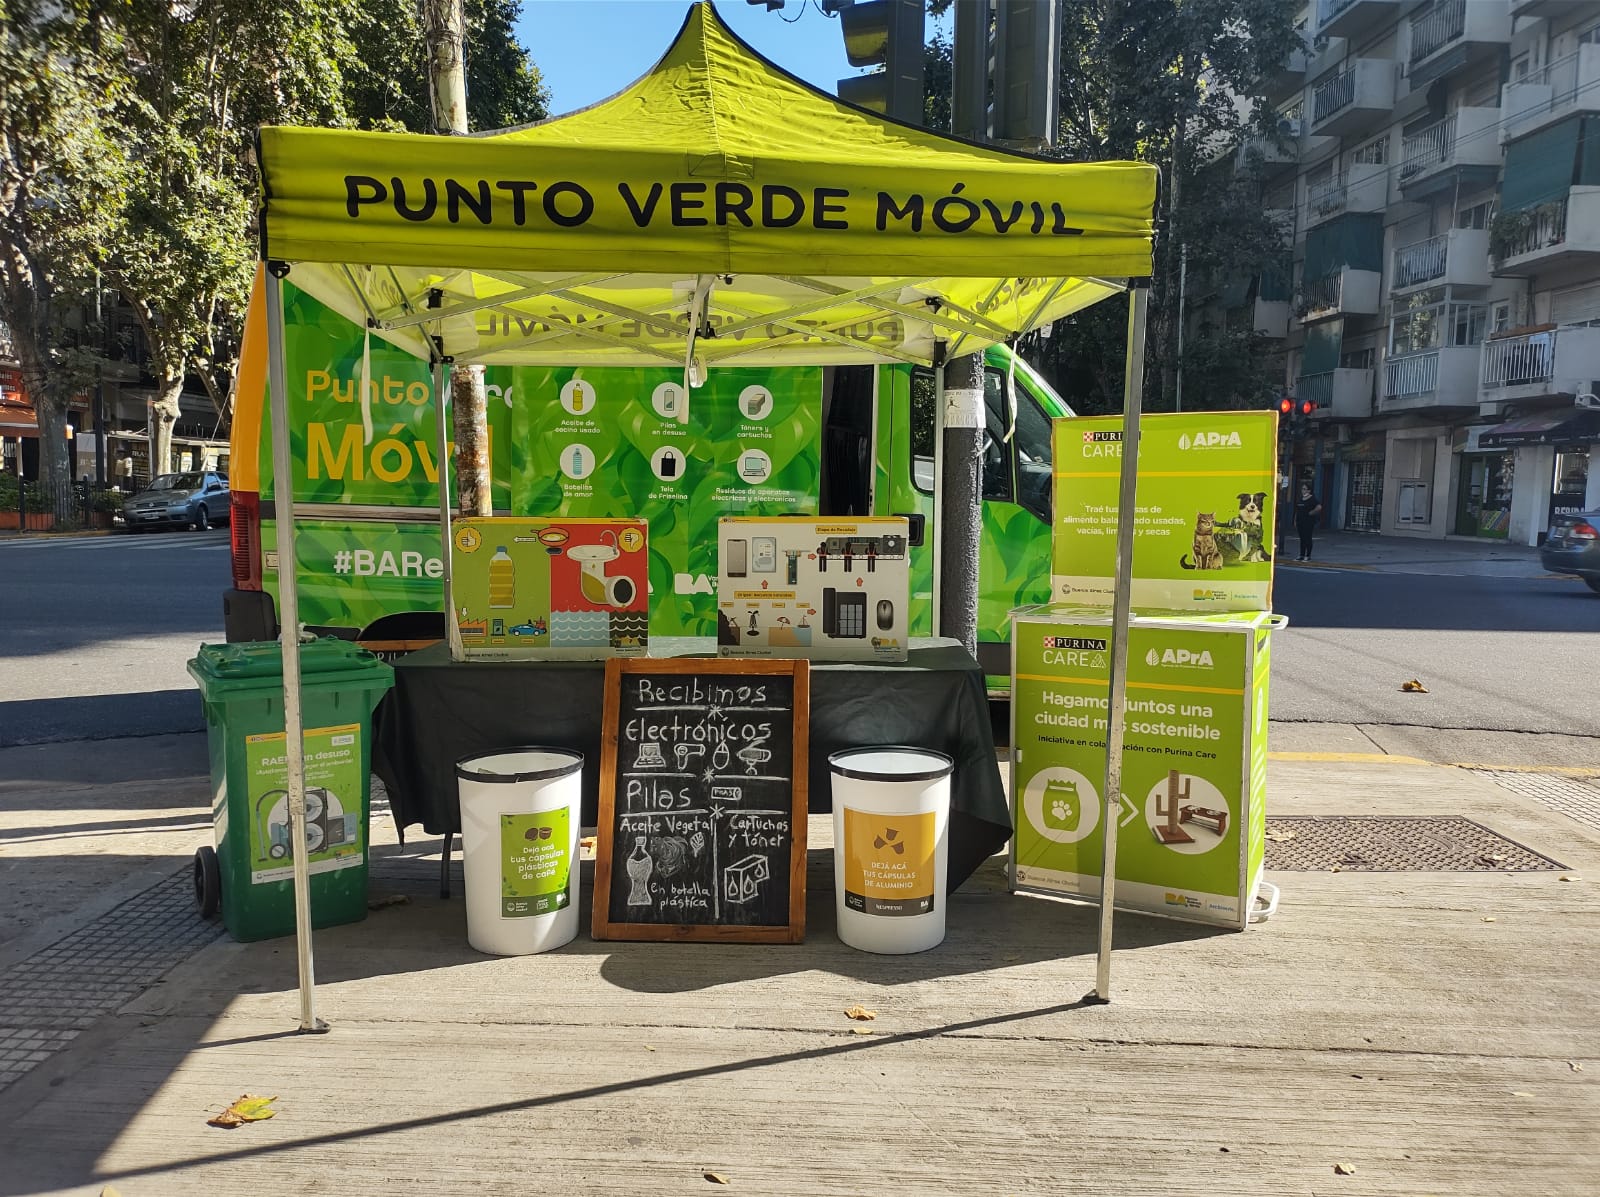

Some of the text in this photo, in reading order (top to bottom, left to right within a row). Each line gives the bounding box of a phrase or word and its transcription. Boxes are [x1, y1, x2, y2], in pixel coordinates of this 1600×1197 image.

[344, 175, 1084, 235] PUNTO VERDE MÓVIL
[1095, 432, 1122, 441] PURI
[1192, 431, 1242, 447] APrA
[307, 423, 493, 483] Móv
[1085, 505, 1104, 513] Traé
[1063, 516, 1099, 524] alimento
[1152, 517, 1186, 526] usadas,
[1077, 526, 1105, 535] vacías,
[1145, 528, 1171, 536] secas
[1056, 639, 1106, 651] PURINA
[1042, 650, 1089, 667] CARE
[1161, 648, 1214, 666] APrA
[638, 677, 767, 705] Recibimos
[1042, 690, 1213, 718] Hagamo juntos una
[625, 714, 772, 743] Electrónicos
[1034, 710, 1221, 741] ciudad ms sostenible
[315, 749, 350, 760] desuso
[1038, 735, 1075, 745] Iniciativa
[1088, 740, 1144, 752] colaación
[1164, 747, 1193, 758] Purina
[1195, 750, 1217, 759] Care
[627, 780, 691, 809] Pilas
[620, 816, 714, 836] Aceite Vegetal
[728, 830, 785, 849] y tóner
[528, 850, 564, 863] cápsulas
[519, 860, 558, 873] plásticas
[891, 862, 907, 870] ACÁ
[521, 869, 556, 880] de café
[863, 870, 916, 879] TUS CÁPSULAS
[671, 882, 711, 897] botella
[864, 880, 874, 888] DE
[660, 897, 709, 913] plástica
